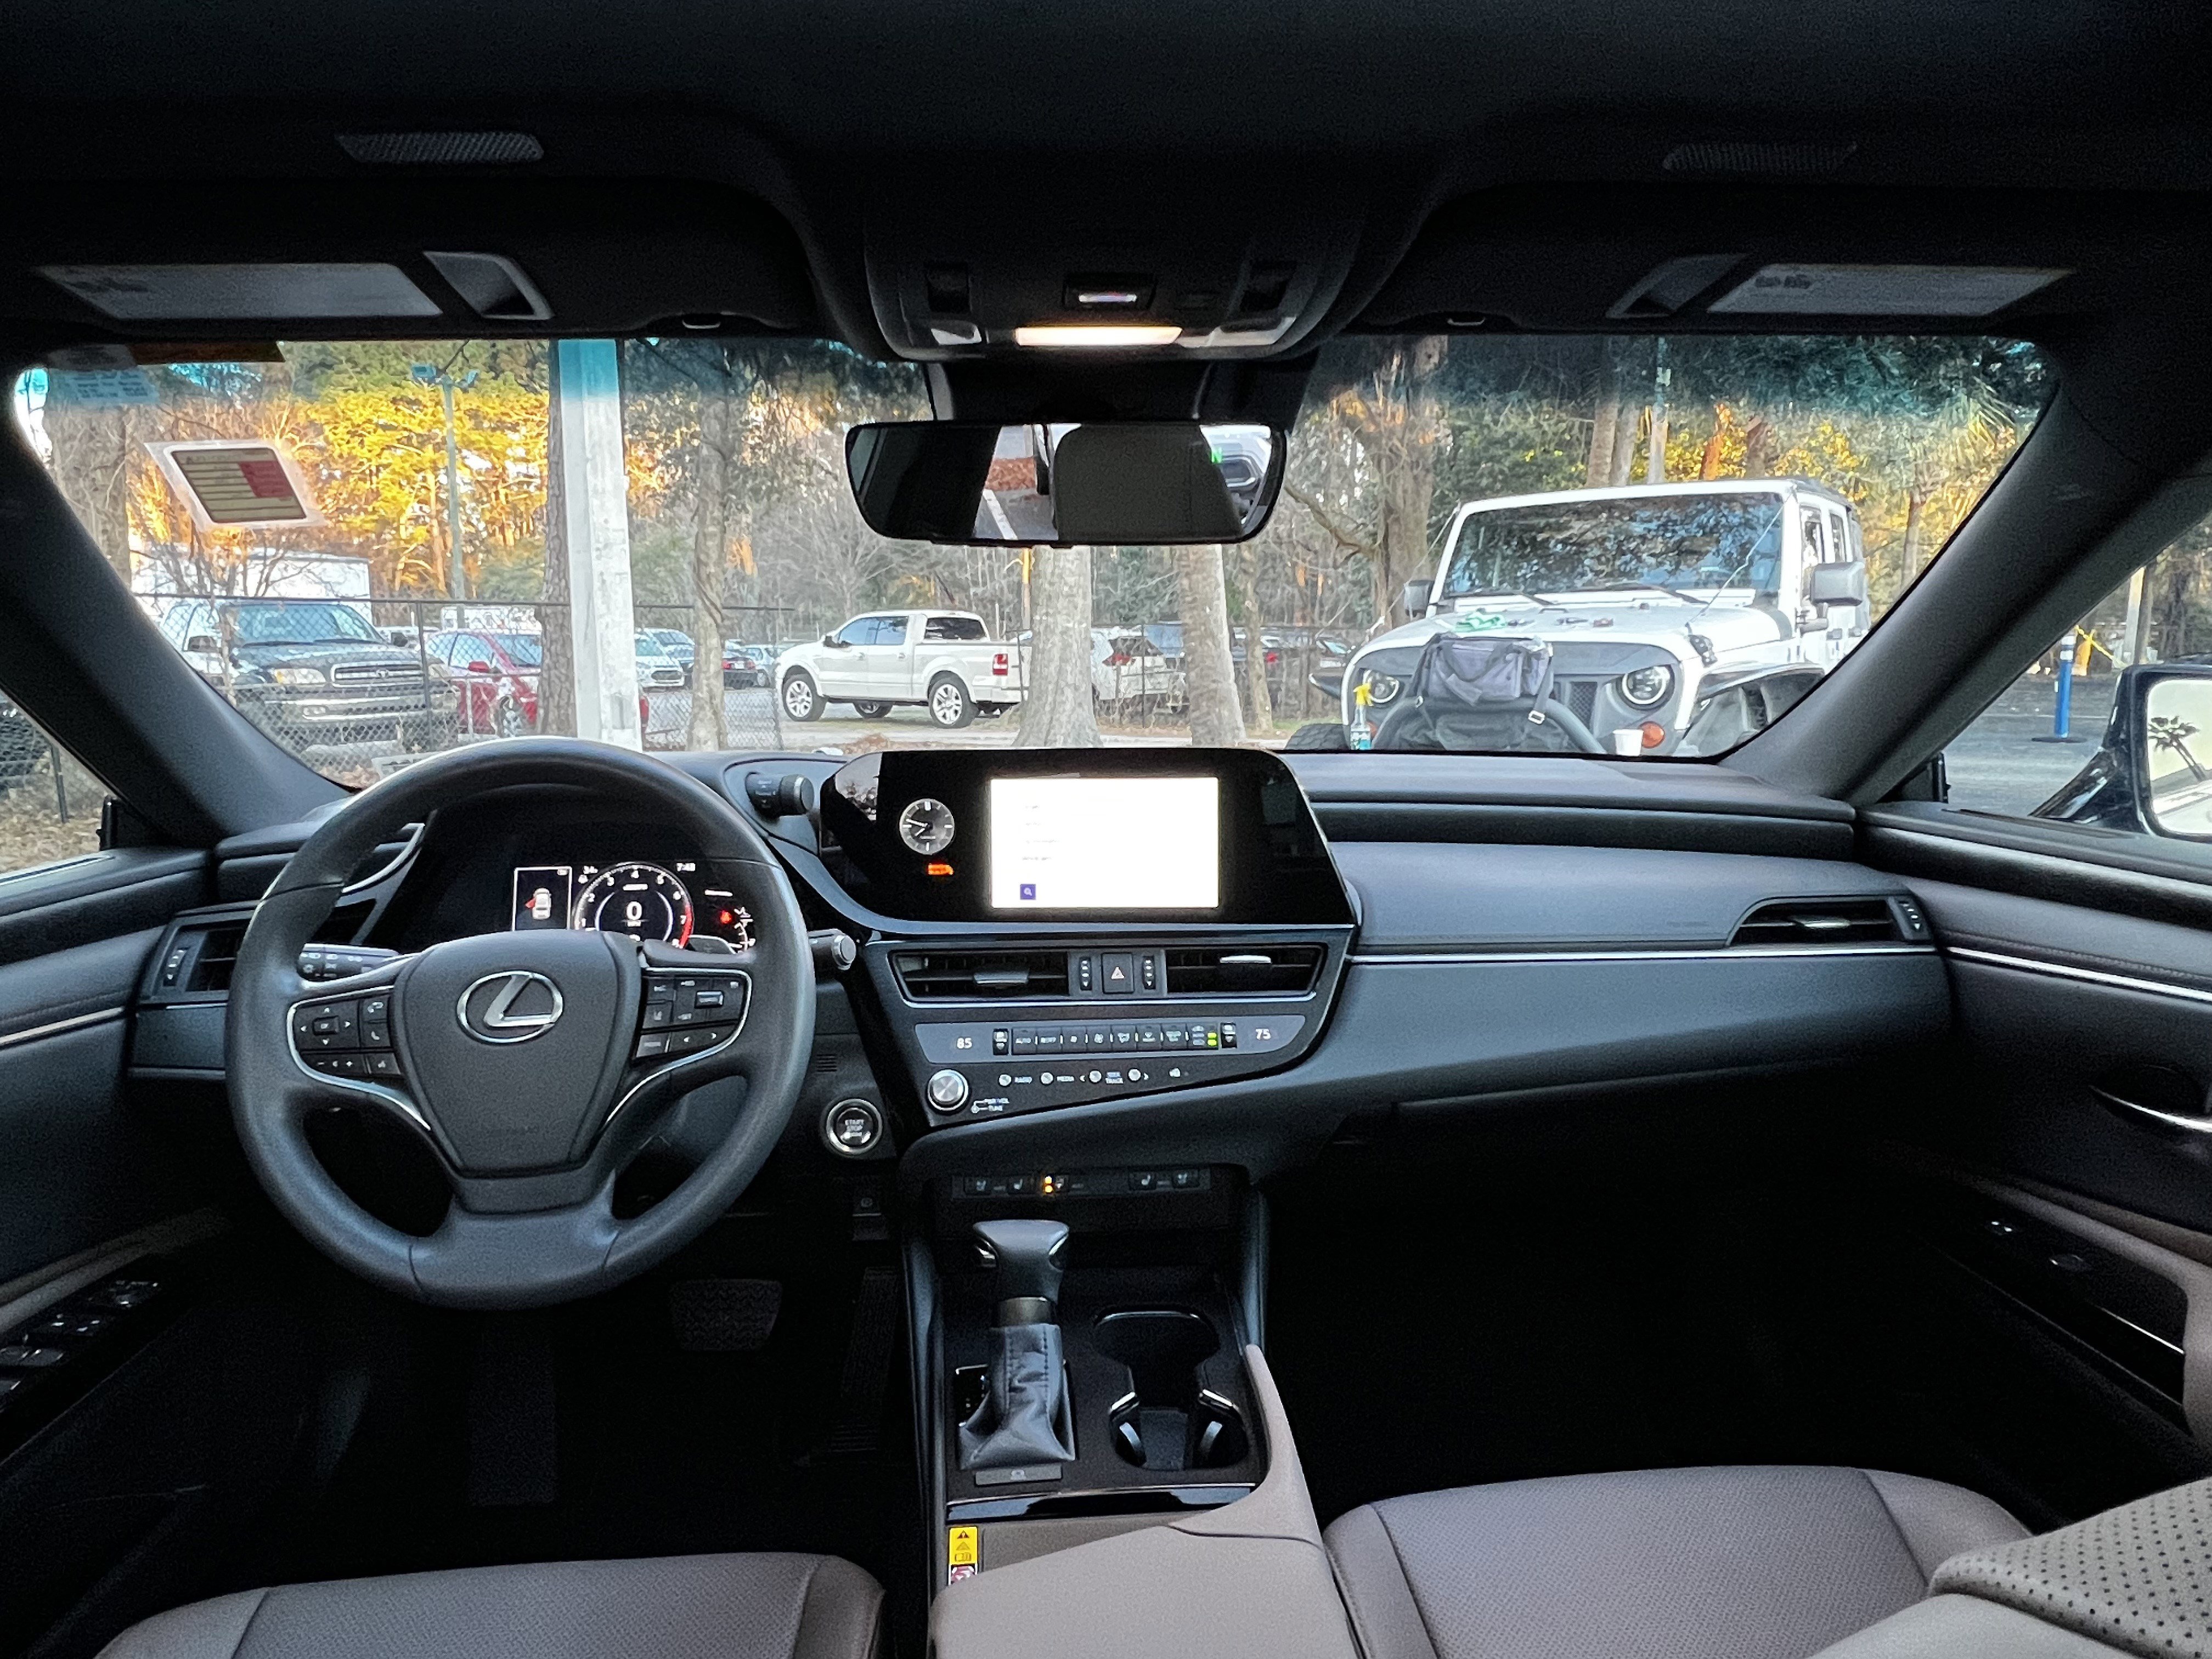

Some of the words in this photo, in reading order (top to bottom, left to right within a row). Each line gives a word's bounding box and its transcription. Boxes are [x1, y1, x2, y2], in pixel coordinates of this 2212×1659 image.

[1211, 447, 1222, 463] N
[588, 893, 595, 902] 2
[627, 901, 642, 920] 0
[582, 918, 586, 927] 1
[680, 915, 686, 924] 7
[1255, 1028, 1271, 1040] 75
